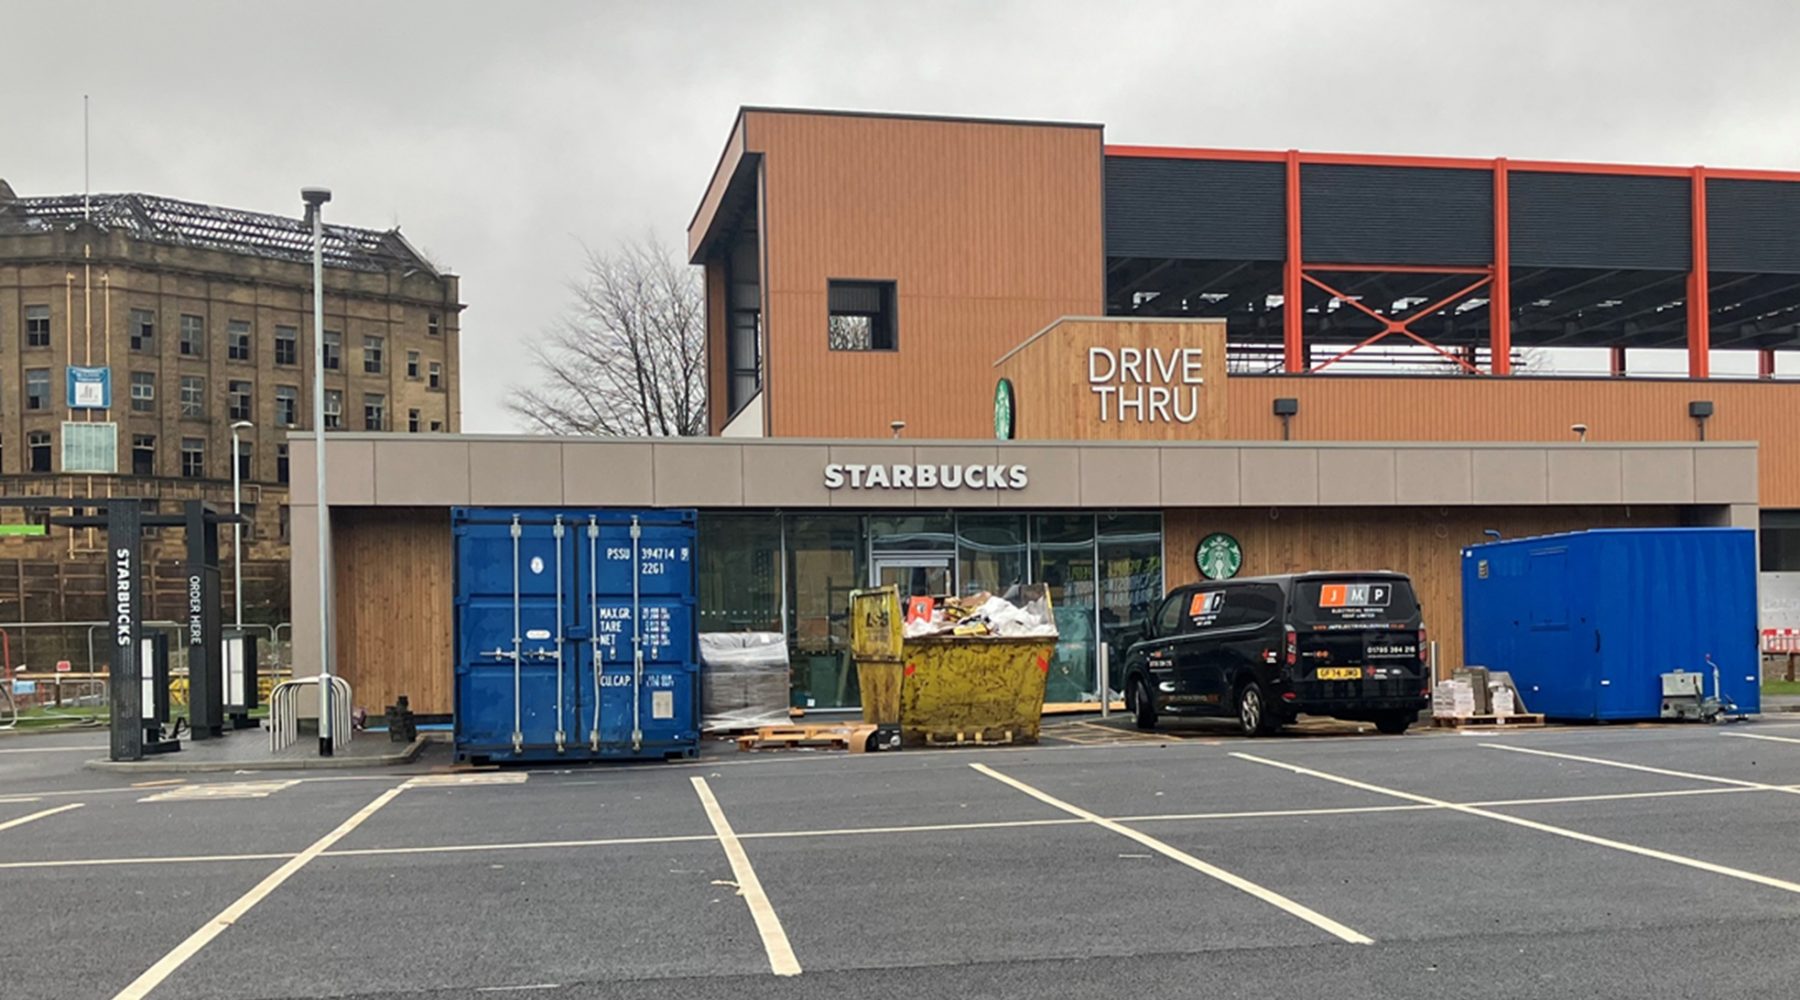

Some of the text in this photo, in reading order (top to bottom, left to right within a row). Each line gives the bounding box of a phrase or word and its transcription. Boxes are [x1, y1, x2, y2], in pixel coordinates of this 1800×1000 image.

[1088, 347, 1204, 384] DRIVE
[1091, 386, 1199, 423] THRU
[824, 464, 1028, 490] STARBUCKS
[606, 547, 631, 560] PSSU
[641, 547, 675, 560] 394714
[116, 548, 130, 646] STARBUCKS
[189, 575, 202, 645] ORDER HERE
[600, 620, 622, 632] TARE
[600, 633, 616, 646] NET
